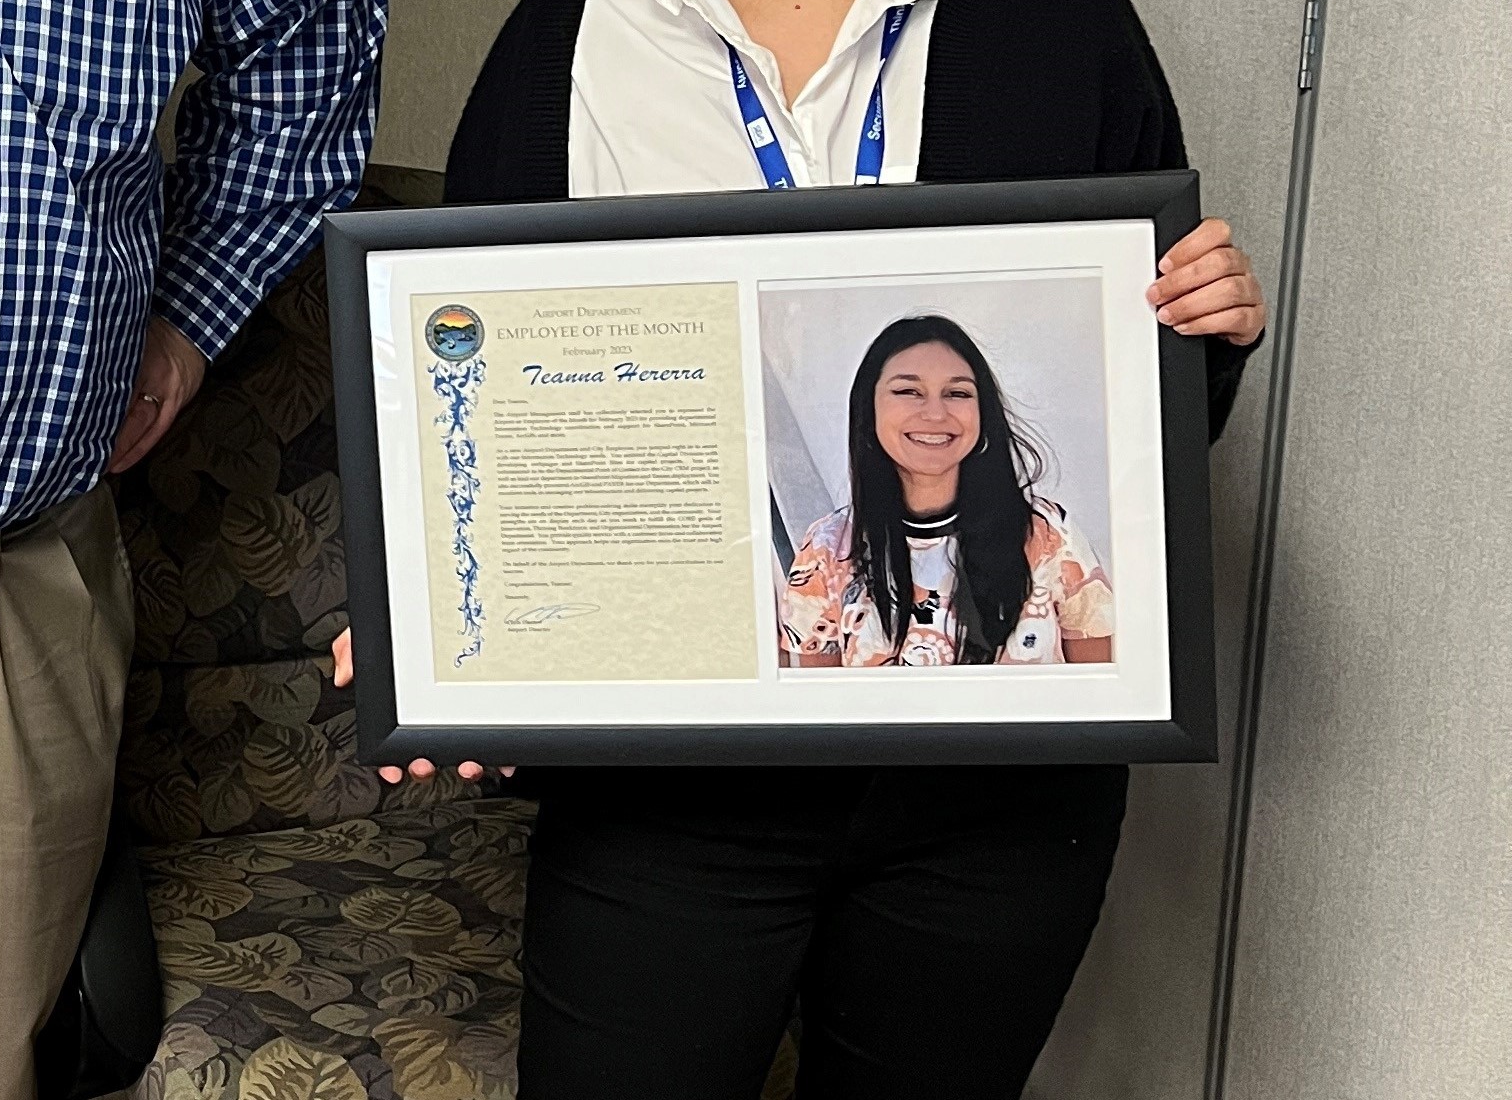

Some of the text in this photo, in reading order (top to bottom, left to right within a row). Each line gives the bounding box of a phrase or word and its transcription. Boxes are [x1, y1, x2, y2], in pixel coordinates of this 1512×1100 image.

[497, 321, 704, 339] EMPLOYEE OF THE MONTH
[562, 345, 633, 358] February 2023
[522, 362, 706, 386] Teanna Hererra
